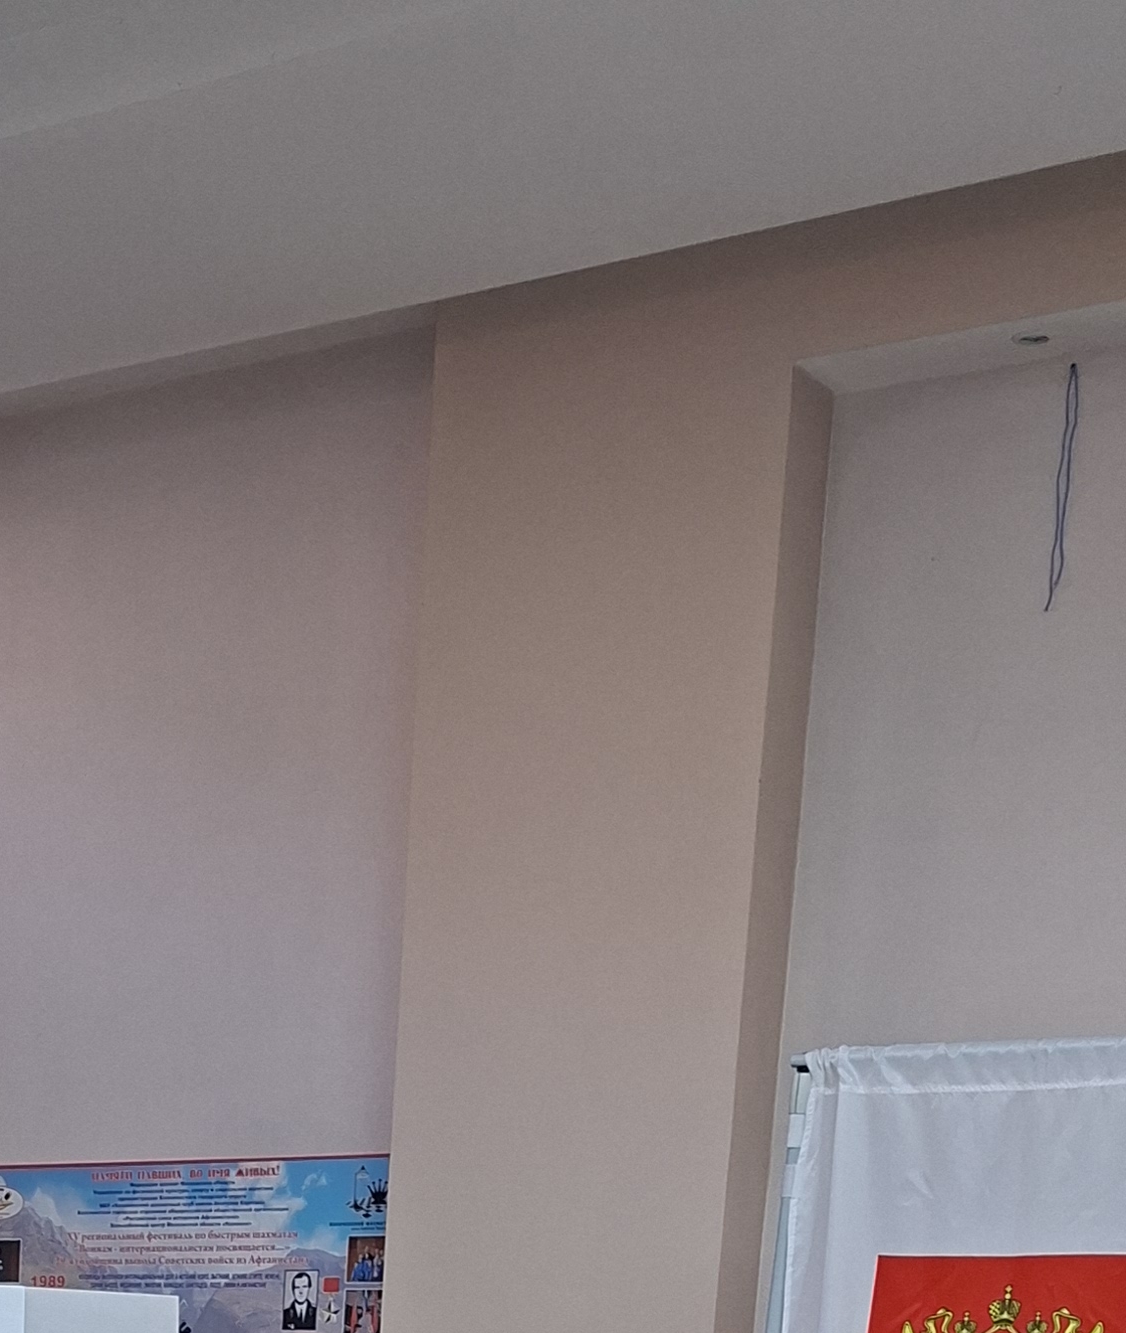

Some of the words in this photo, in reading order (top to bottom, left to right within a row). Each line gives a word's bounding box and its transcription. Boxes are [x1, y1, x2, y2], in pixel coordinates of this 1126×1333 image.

[146, 1231, 193, 1243] фестиваль
[208, 1230, 251, 1242] быстрым
[208, 1256, 234, 1265] войск
[31, 1275, 66, 1288] 1989
